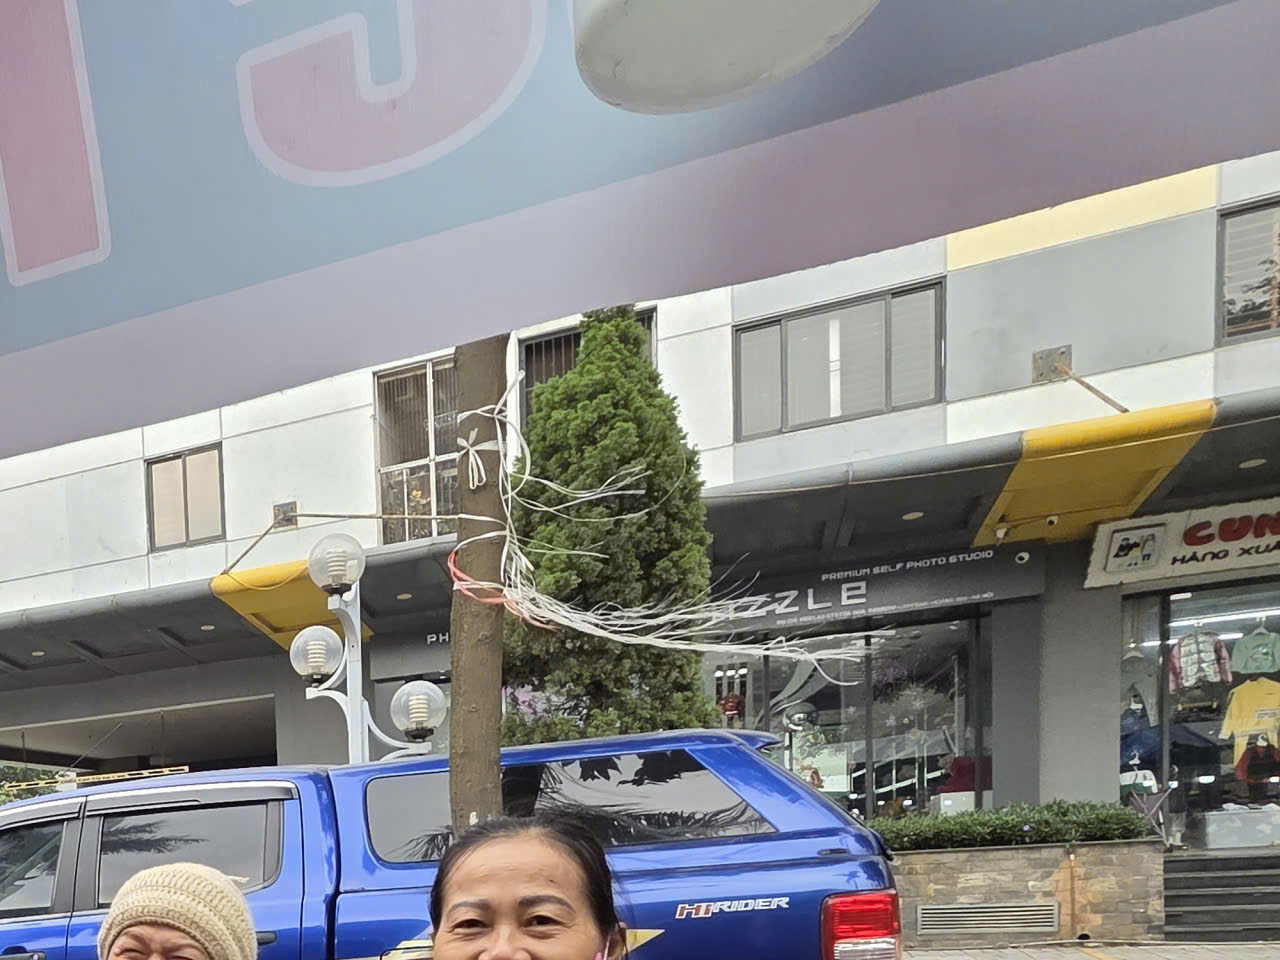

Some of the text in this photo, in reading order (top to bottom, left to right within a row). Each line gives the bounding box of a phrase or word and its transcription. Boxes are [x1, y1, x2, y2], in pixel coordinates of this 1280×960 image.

[821, 549, 993, 581] PREMIUM SELF PHOTO STUDIO
